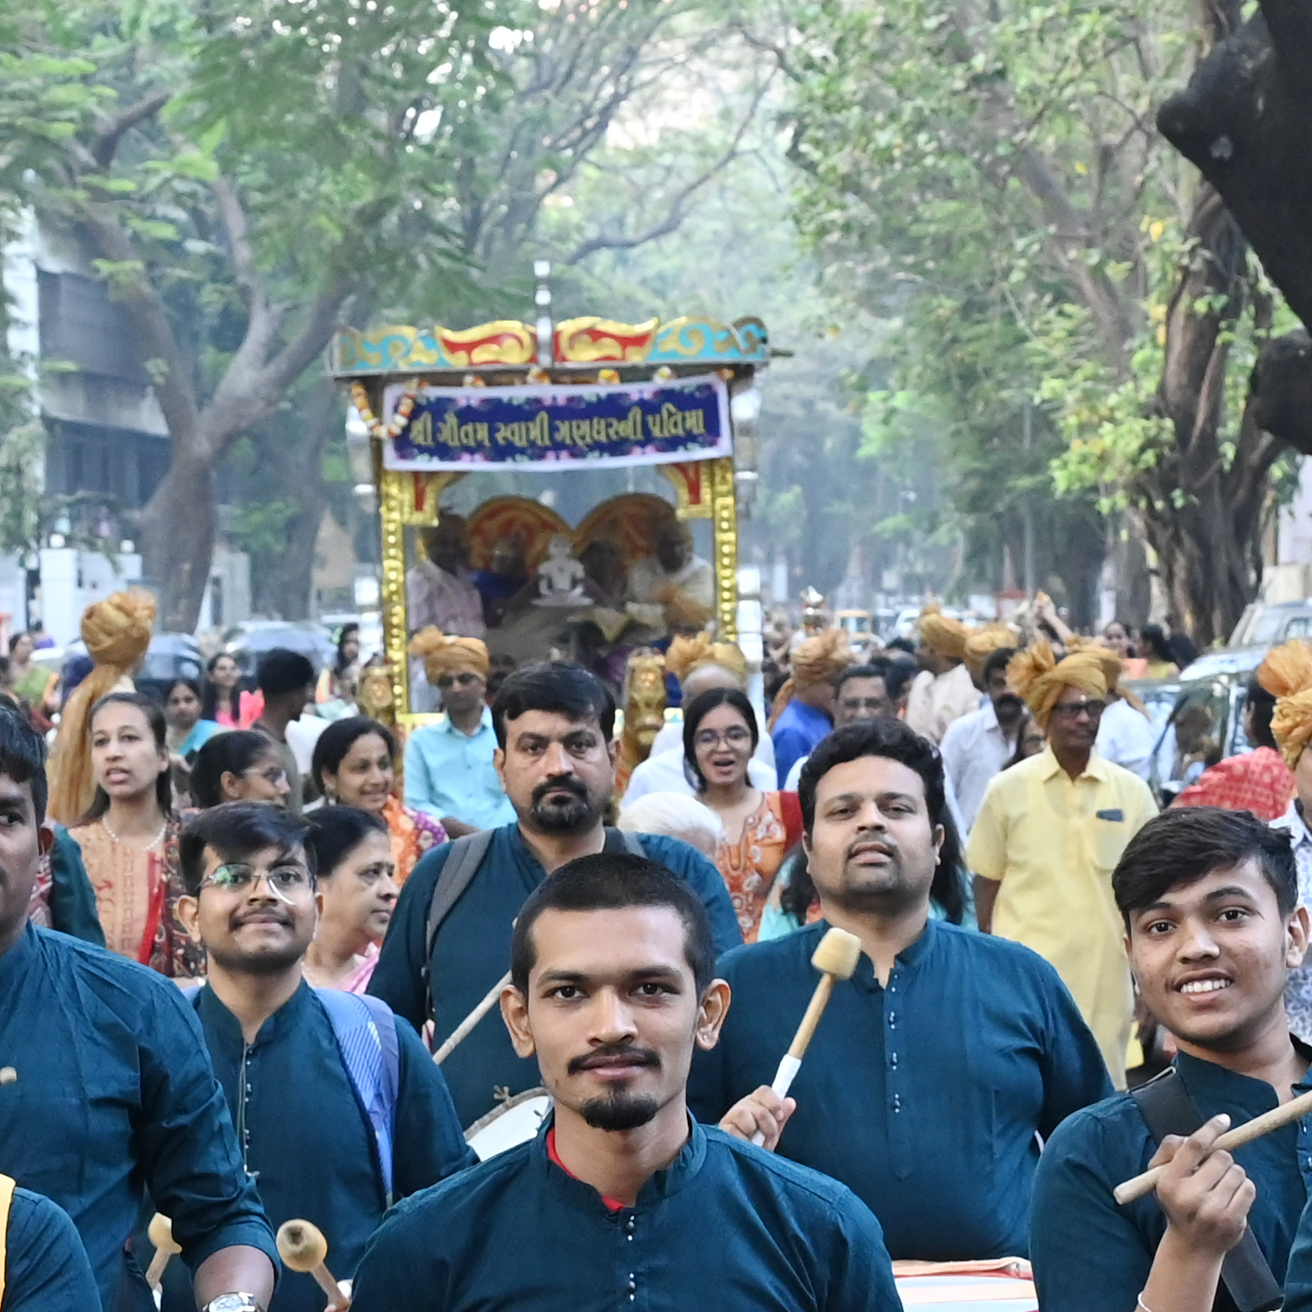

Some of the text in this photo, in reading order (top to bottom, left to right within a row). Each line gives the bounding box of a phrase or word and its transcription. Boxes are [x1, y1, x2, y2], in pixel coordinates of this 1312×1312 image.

[410, 402, 705, 449] શ્રી ગૌતમ સ્વામી ગણધરની પ્રતિમા
